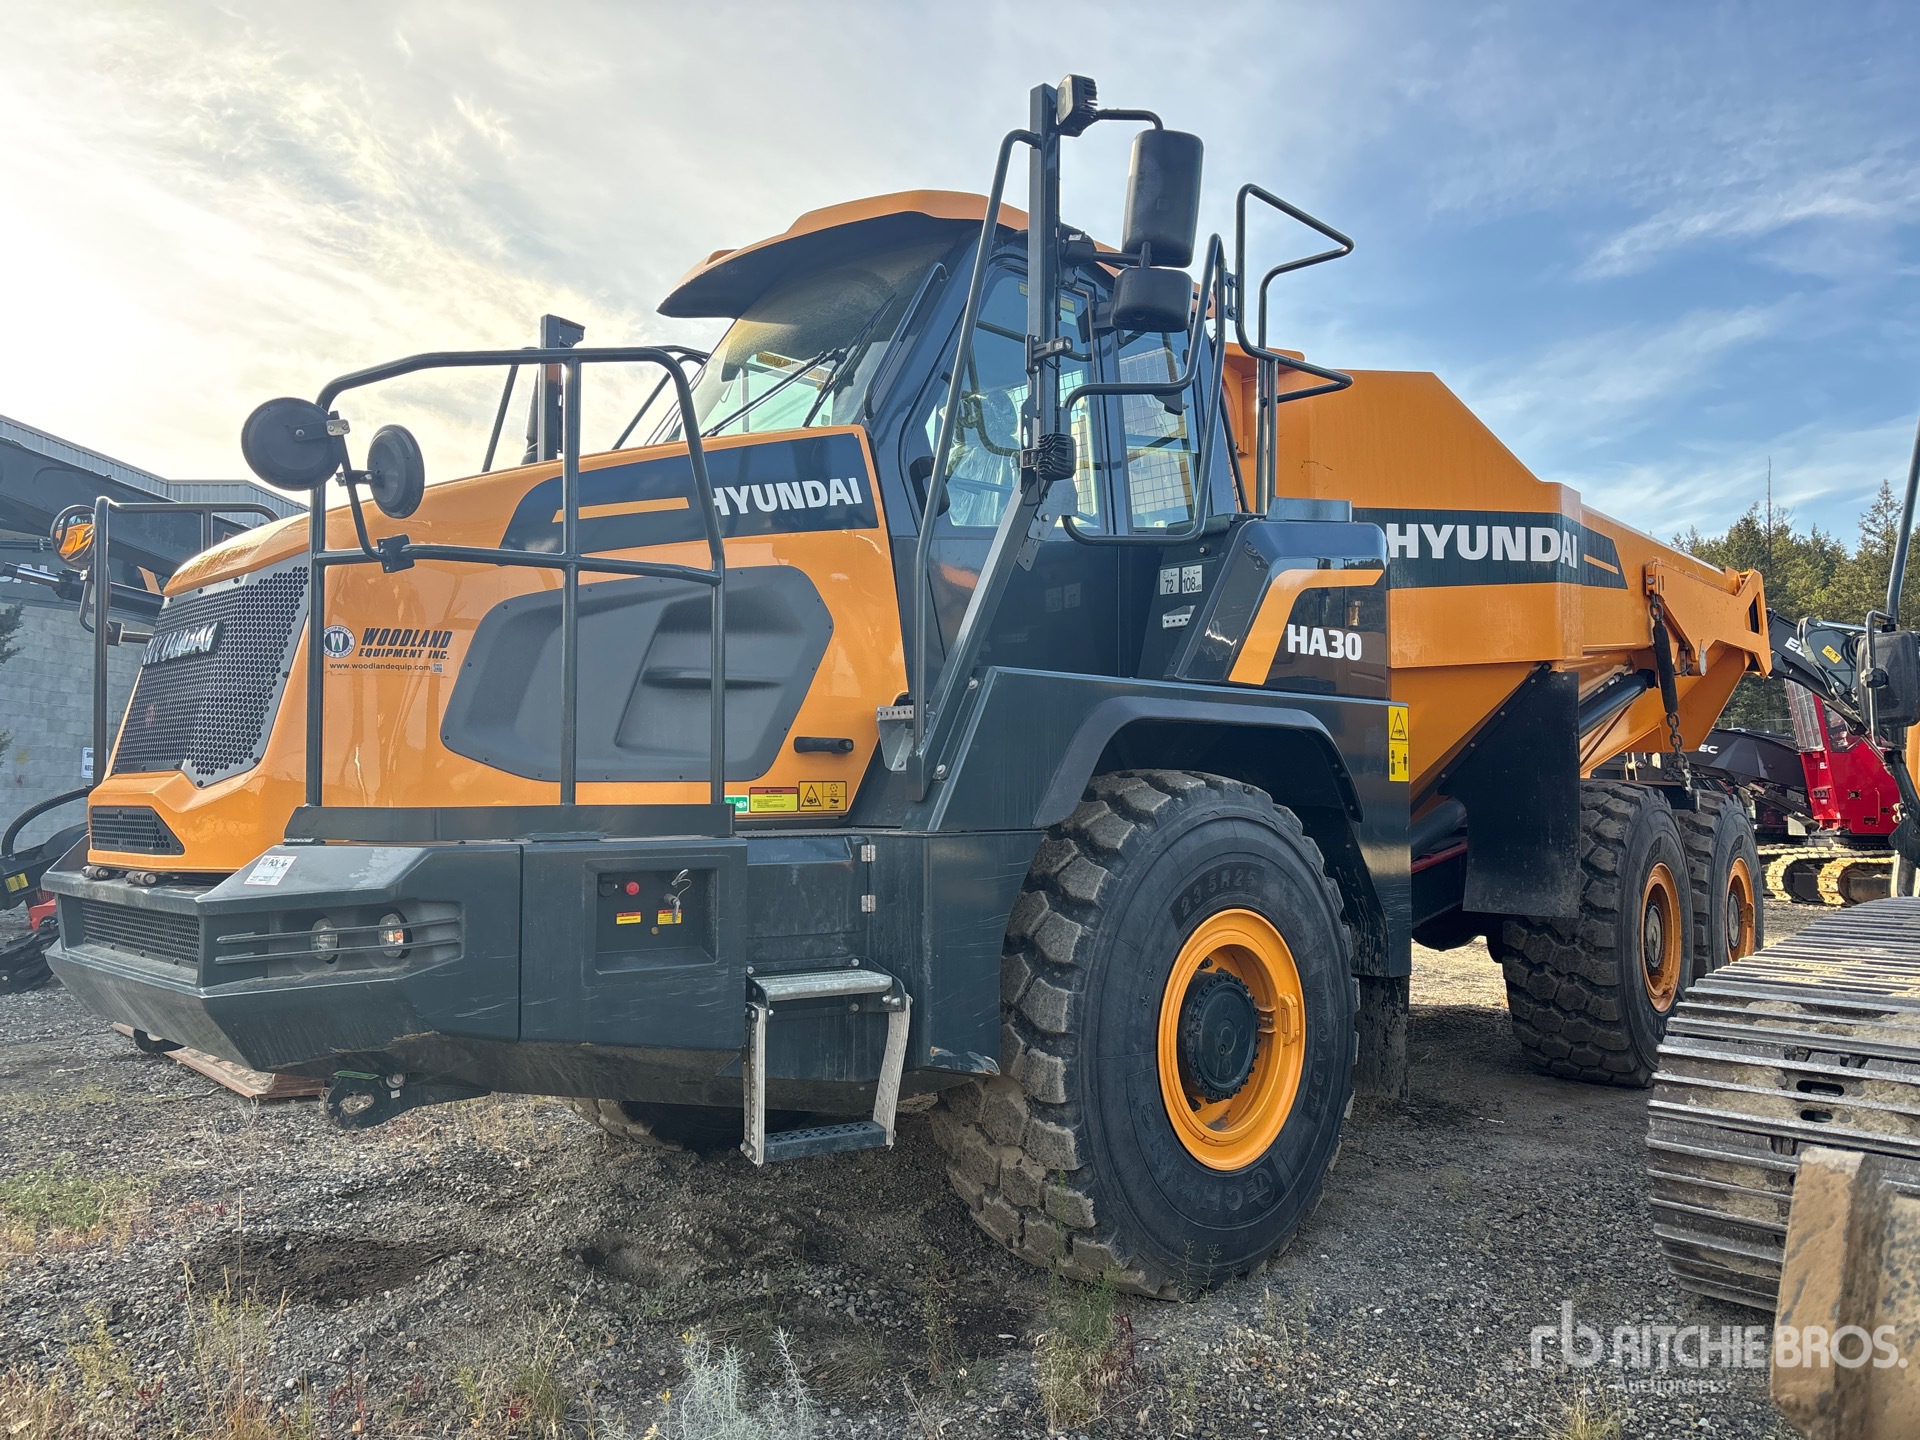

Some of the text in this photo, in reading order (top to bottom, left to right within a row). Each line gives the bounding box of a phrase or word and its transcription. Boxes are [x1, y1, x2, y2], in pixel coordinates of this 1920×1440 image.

[1386, 523, 1578, 569] HYUNDAI
[1165, 579, 1174, 593] 72
[361, 627, 453, 649] WOODLAND
[1287, 623, 1362, 661] HA30
[358, 648, 450, 660] EQUIPMENT INC.
[329, 662, 431, 672] www.woodlandequip.com
[1181, 868, 1257, 916] 23.5R25
